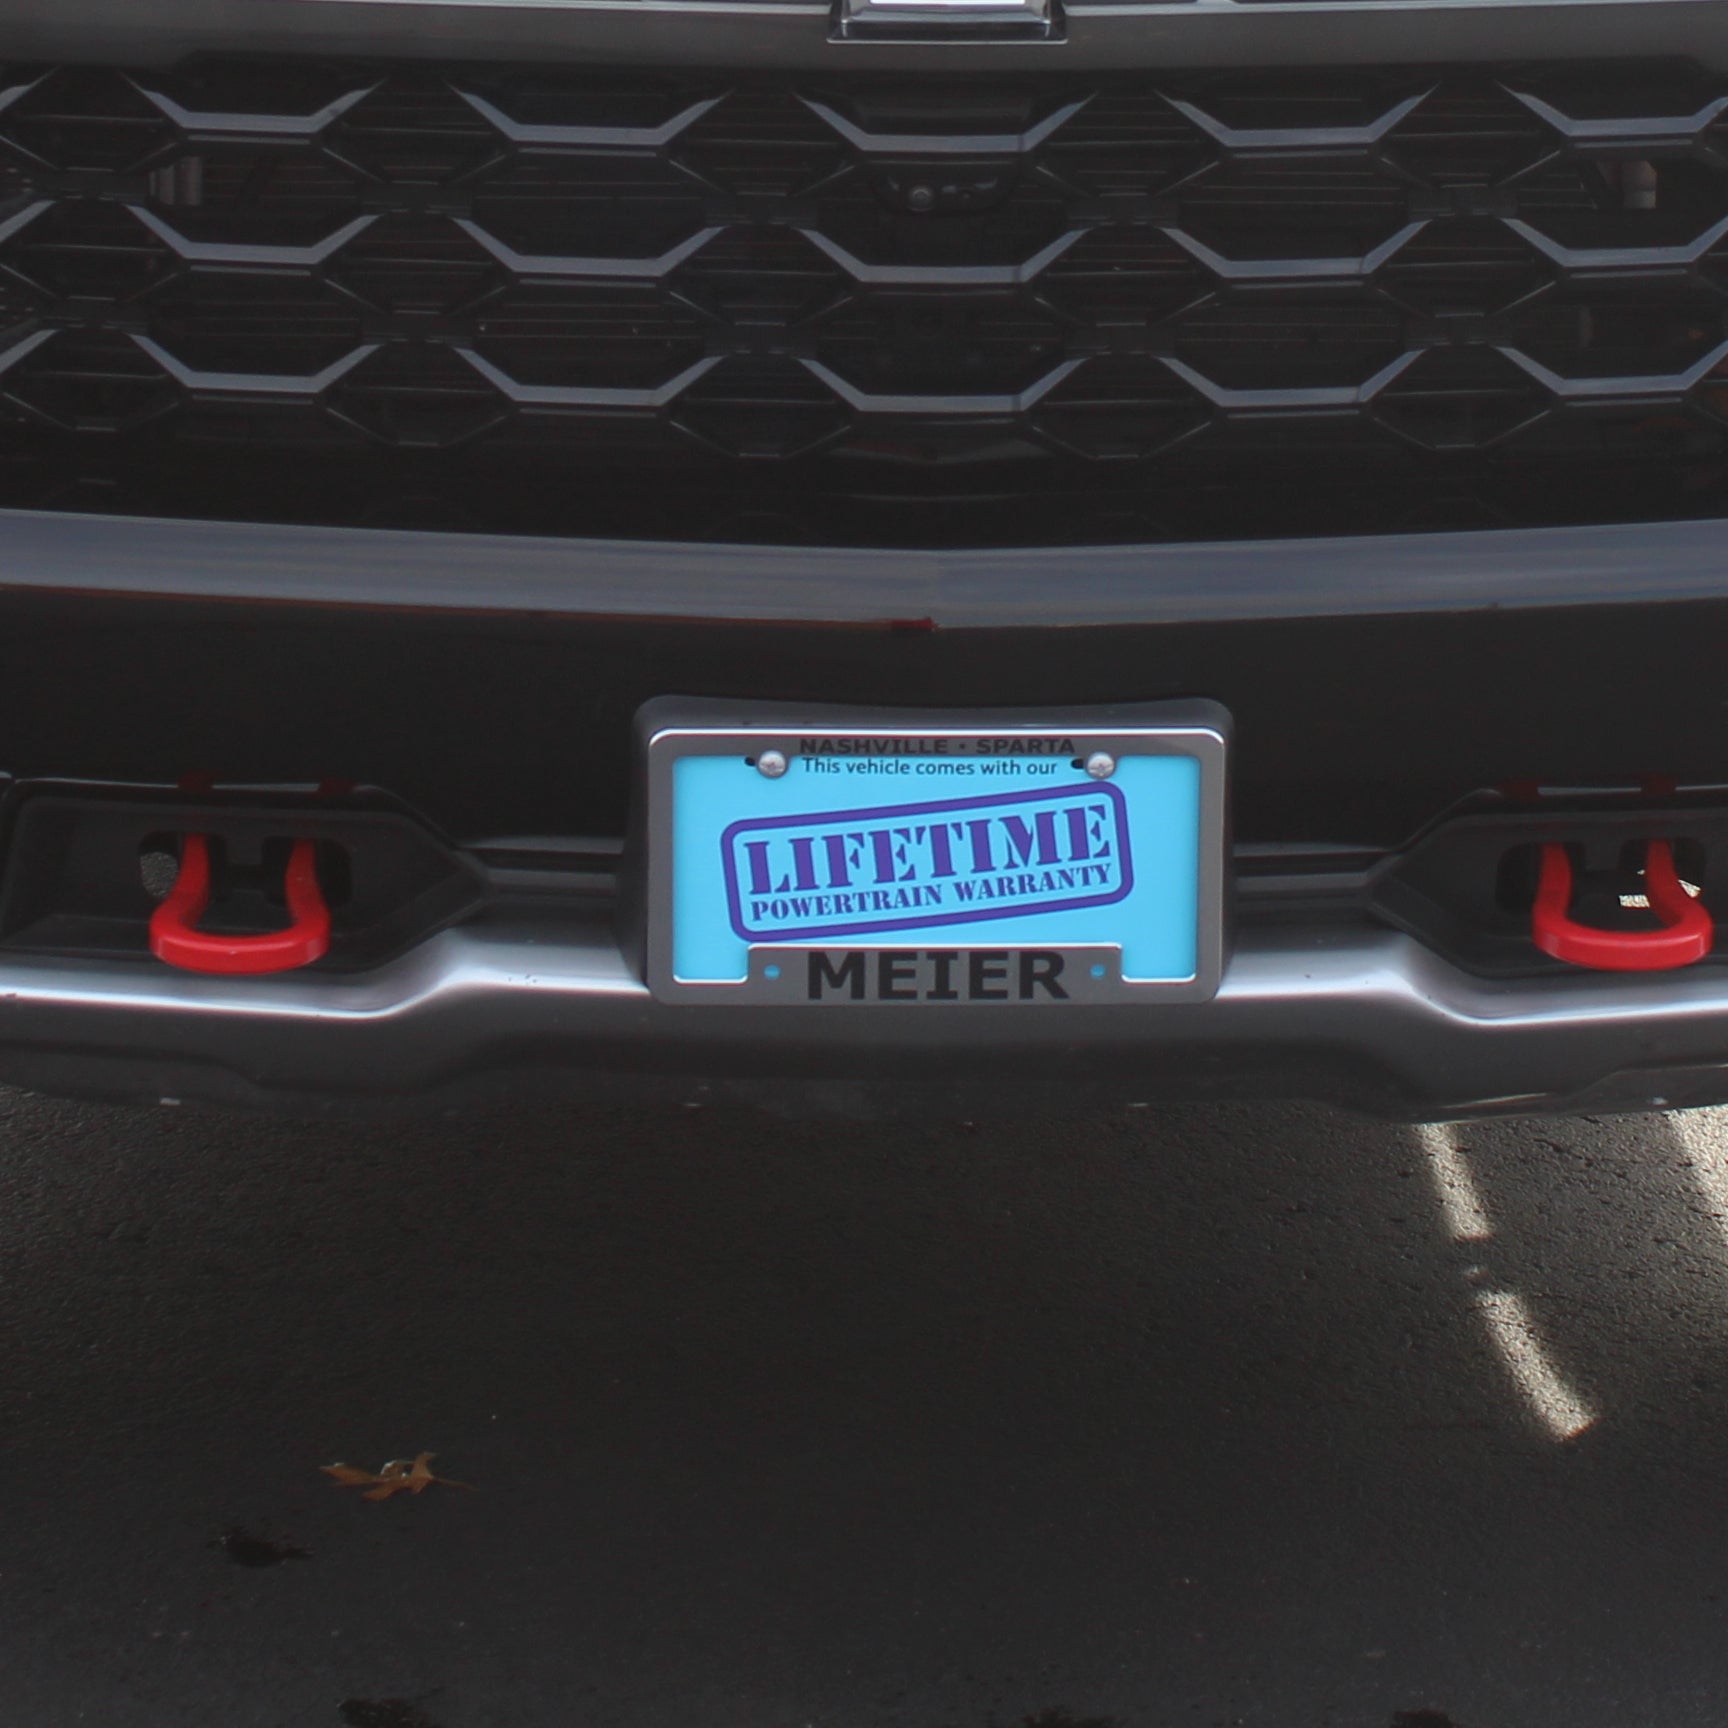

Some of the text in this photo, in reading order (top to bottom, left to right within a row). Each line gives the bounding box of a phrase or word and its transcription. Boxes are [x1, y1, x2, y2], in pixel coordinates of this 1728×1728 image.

[799, 737, 1076, 755] NASHVILLE SPARTA
[803, 757, 1058, 776] This vehicle comes with our
[744, 803, 1112, 896] LIFETIME
[751, 864, 1113, 922] POWERTRAIN WARRANTY
[807, 949, 1070, 1001] MEIER
